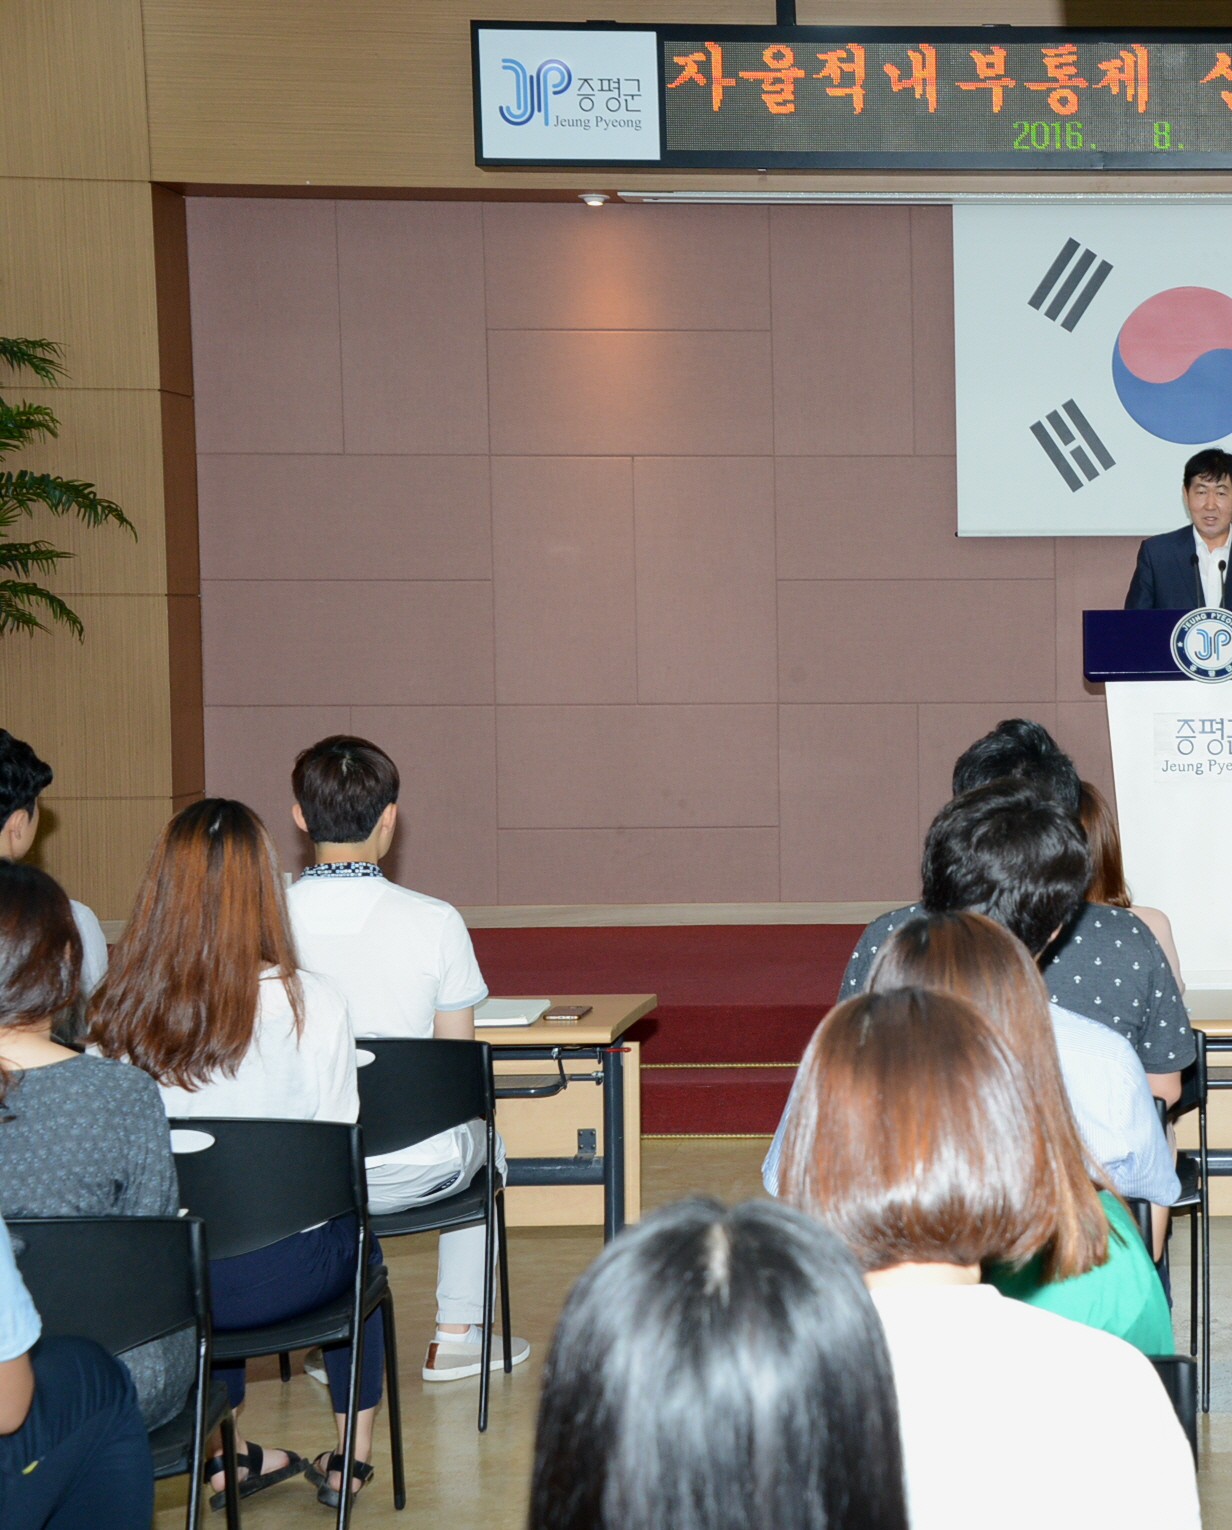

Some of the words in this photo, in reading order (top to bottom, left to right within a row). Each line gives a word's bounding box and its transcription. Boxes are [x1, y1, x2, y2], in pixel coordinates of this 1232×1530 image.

[576, 77, 642, 112] 증평군
[553, 115, 592, 131] Jeung
[594, 115, 643, 131] Pyeong
[1013, 120, 1097, 150] 2016.
[1153, 120, 1185, 150] 8.
[1182, 613, 1208, 631] JEUNG
[1161, 759, 1204, 775] Jeung
